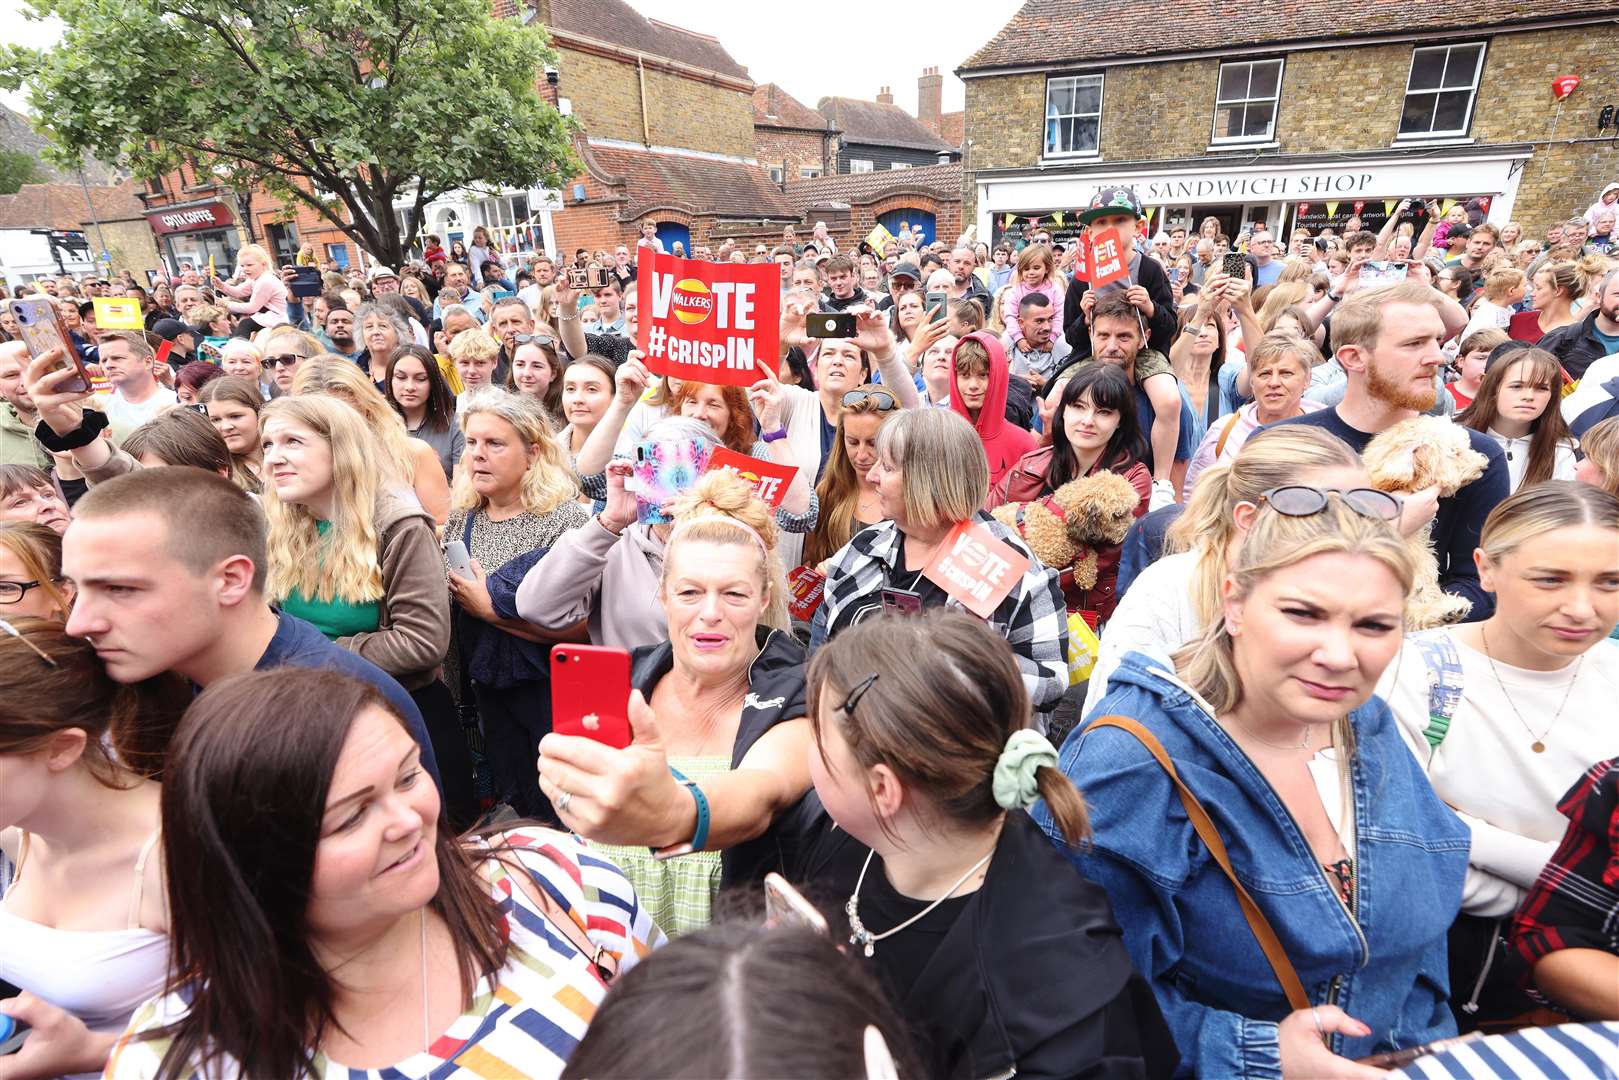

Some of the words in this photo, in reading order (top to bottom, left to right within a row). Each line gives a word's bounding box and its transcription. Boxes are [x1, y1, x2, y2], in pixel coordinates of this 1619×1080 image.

[1148, 178, 1288, 199] SANDWICH
[1298, 174, 1373, 193] SHOP
[183, 209, 217, 223] COFFEE
[672, 292, 712, 310] WALKERS
[648, 325, 755, 371] #CRISPIN
